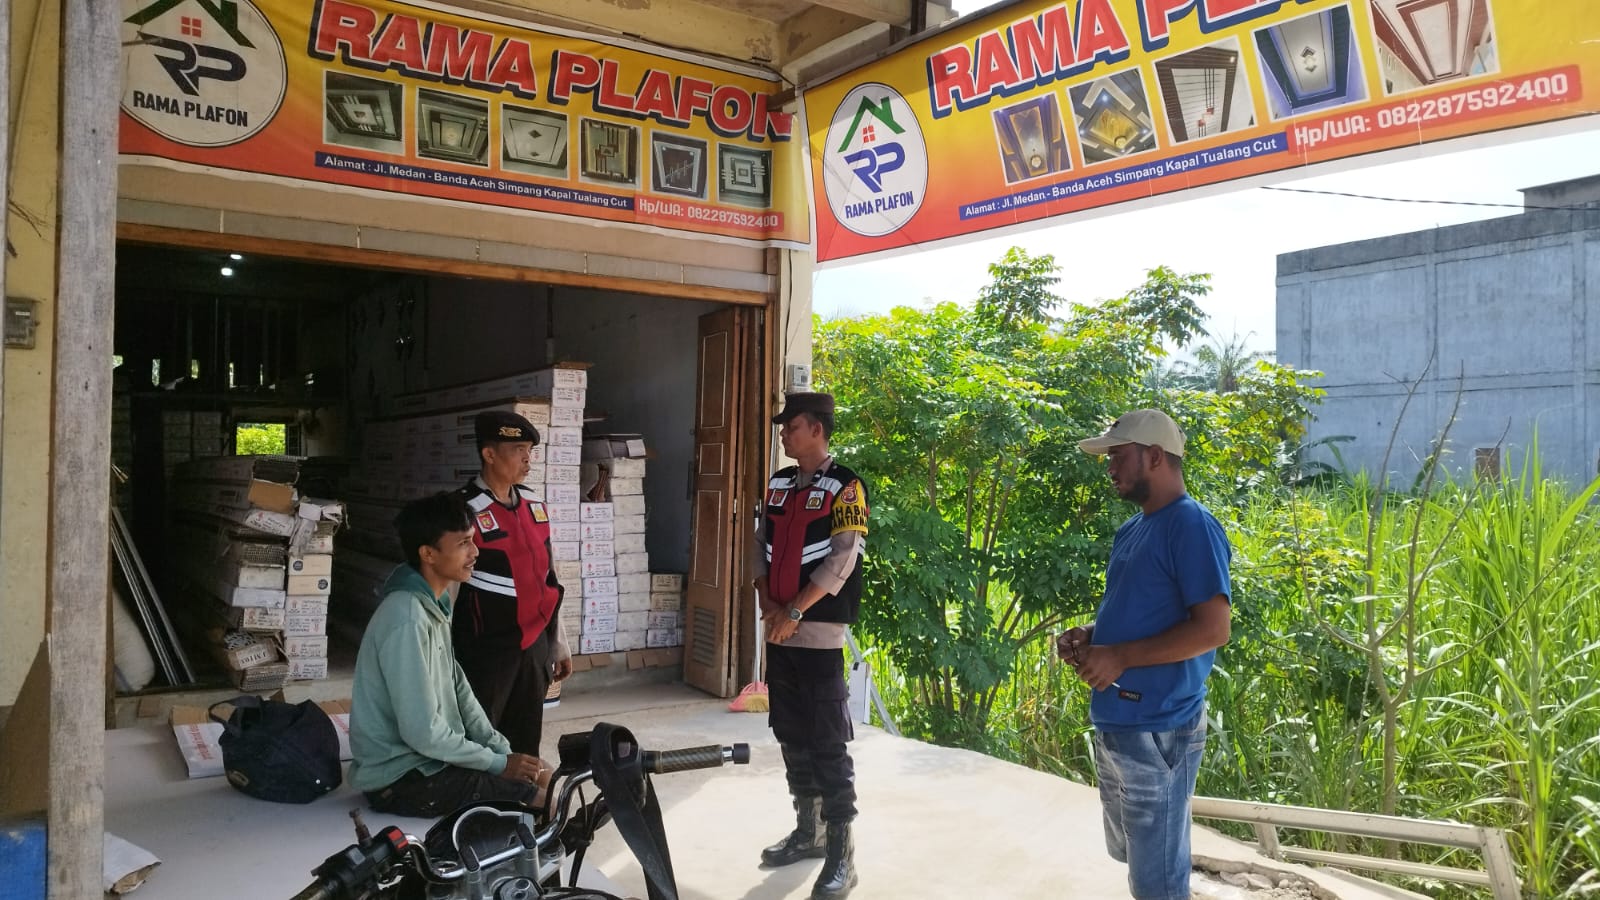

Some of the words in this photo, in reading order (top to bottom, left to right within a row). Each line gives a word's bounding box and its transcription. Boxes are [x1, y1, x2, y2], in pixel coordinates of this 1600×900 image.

[308, 0, 537, 100] RAMA
[547, 49, 793, 142] PLAFON
[926, 0, 1130, 119] RAMA
[133, 90, 180, 116] RAMA
[184, 101, 248, 127] PLAFON
[1295, 114, 1372, 147] Hp/WA:
[1377, 73, 1569, 130] 082287592400
[324, 156, 365, 170] Alamat
[374, 164, 387, 174] Jl.
[390, 166, 425, 179] Medan
[434, 172, 468, 185] Banda
[469, 177, 496, 189] Aceh
[498, 181, 542, 197] Simpang
[544, 187, 571, 201] Kapal
[573, 191, 609, 207] Tualang
[610, 197, 628, 207] Cut
[845, 201, 874, 219] RAMA
[874, 191, 915, 213] PLAFON
[965, 201, 996, 216] Alamat
[1002, 198, 1013, 209] Jl.
[1014, 191, 1045, 206] Medan
[1052, 182, 1085, 197] Banda
[1086, 175, 1113, 190] Aceh
[1114, 166, 1163, 183] Simpang
[1166, 156, 1199, 172] Kapal
[1201, 145, 1250, 163] Tualang
[1253, 138, 1277, 153] Cut
[687, 206, 778, 228] 082287592400
